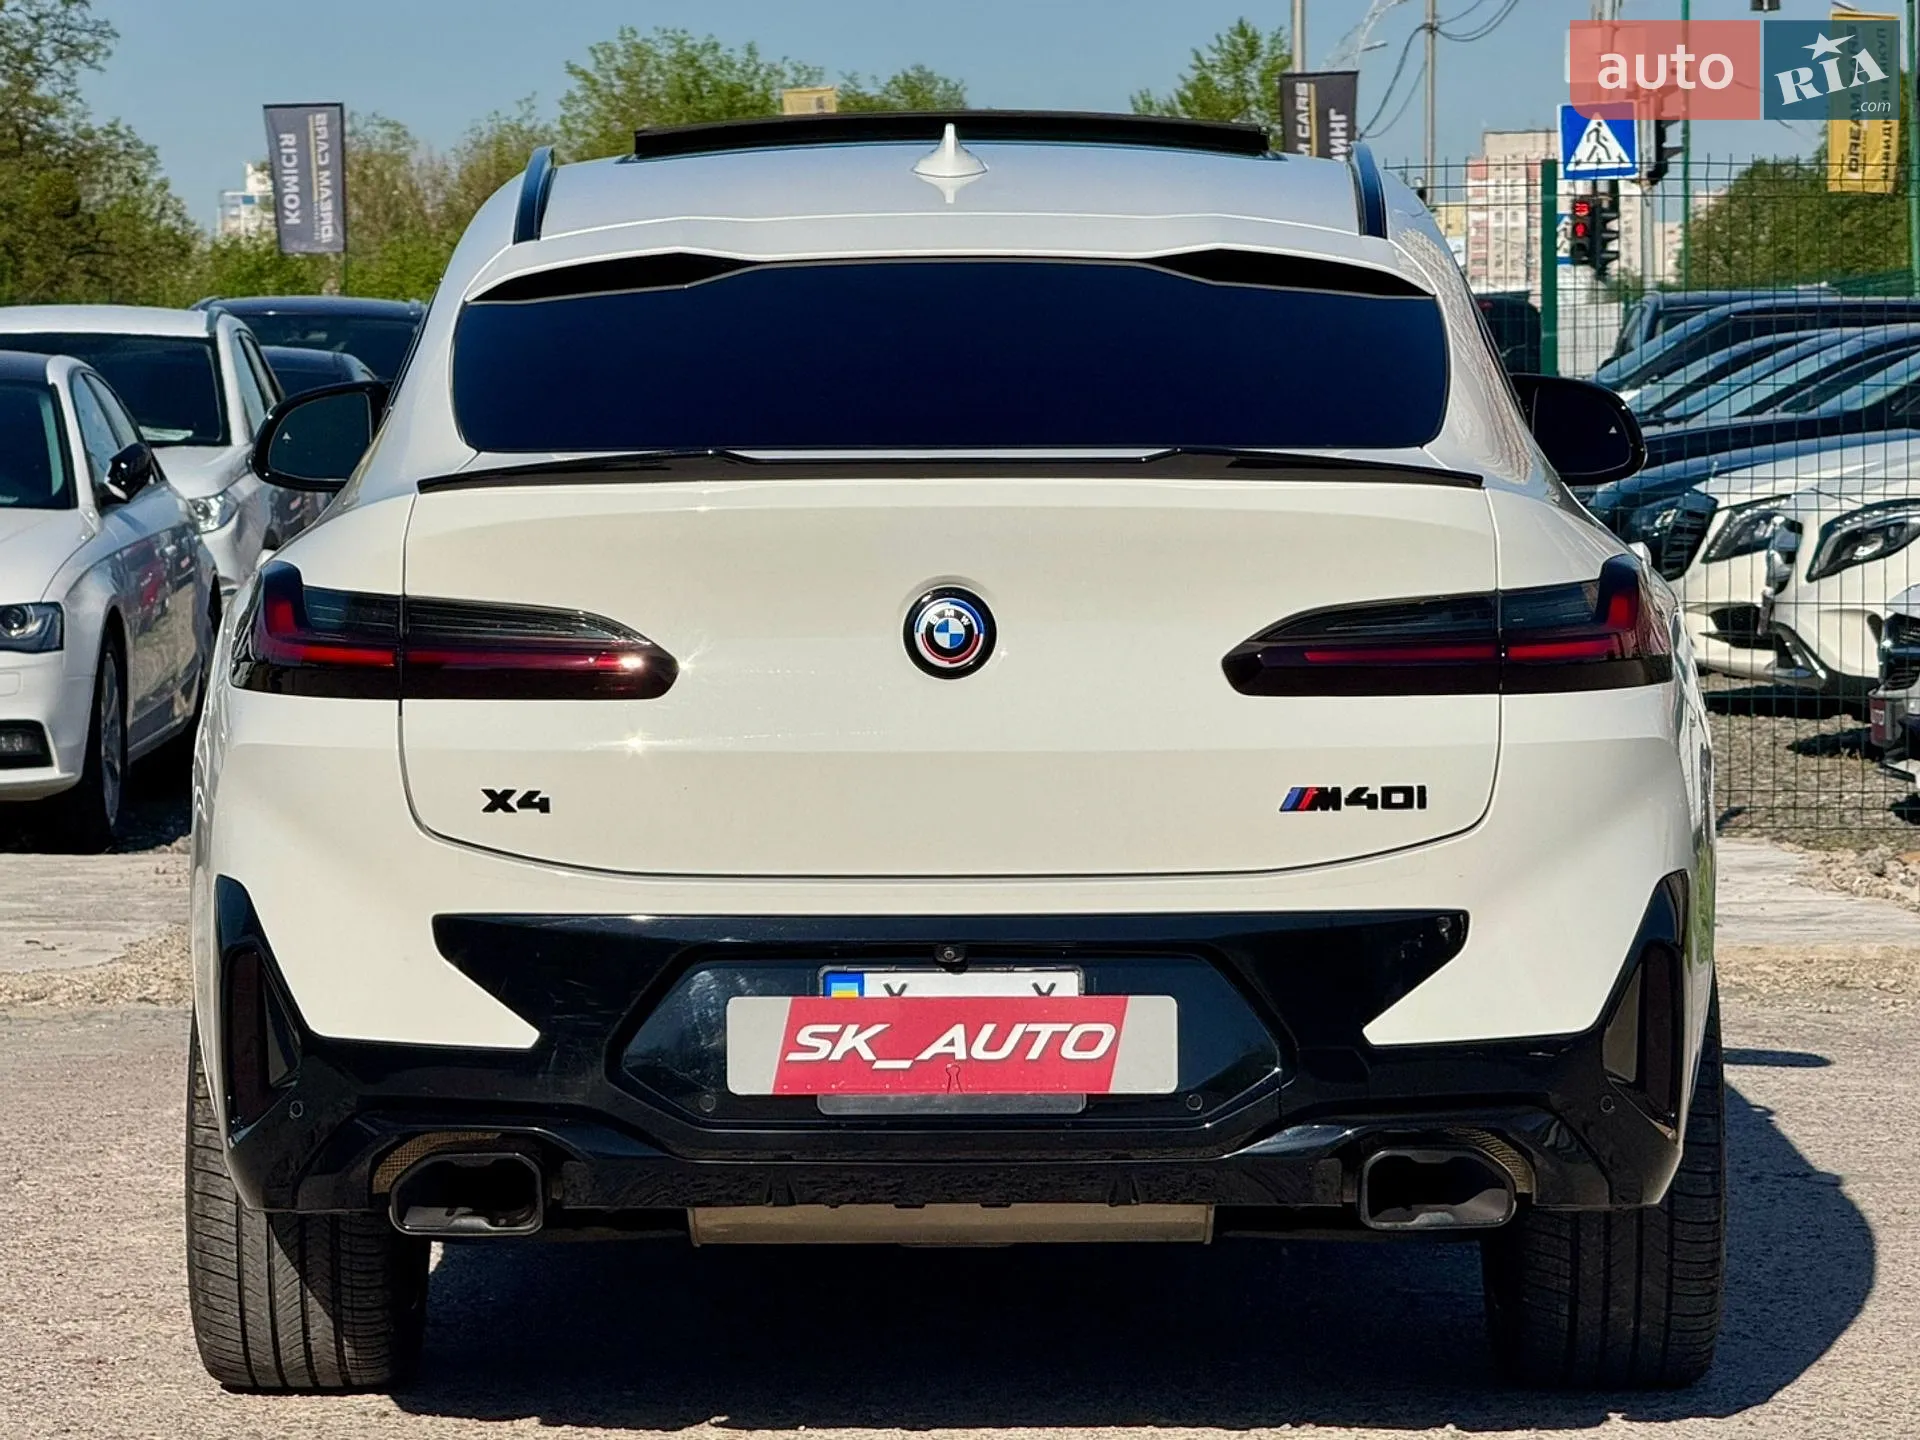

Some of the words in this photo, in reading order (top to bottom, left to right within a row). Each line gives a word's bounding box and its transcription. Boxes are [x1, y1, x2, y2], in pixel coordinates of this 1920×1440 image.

[928, 607, 971, 625] BMW
[481, 788, 550, 814] X4
[785, 1023, 1117, 1069] SK_AUTO
